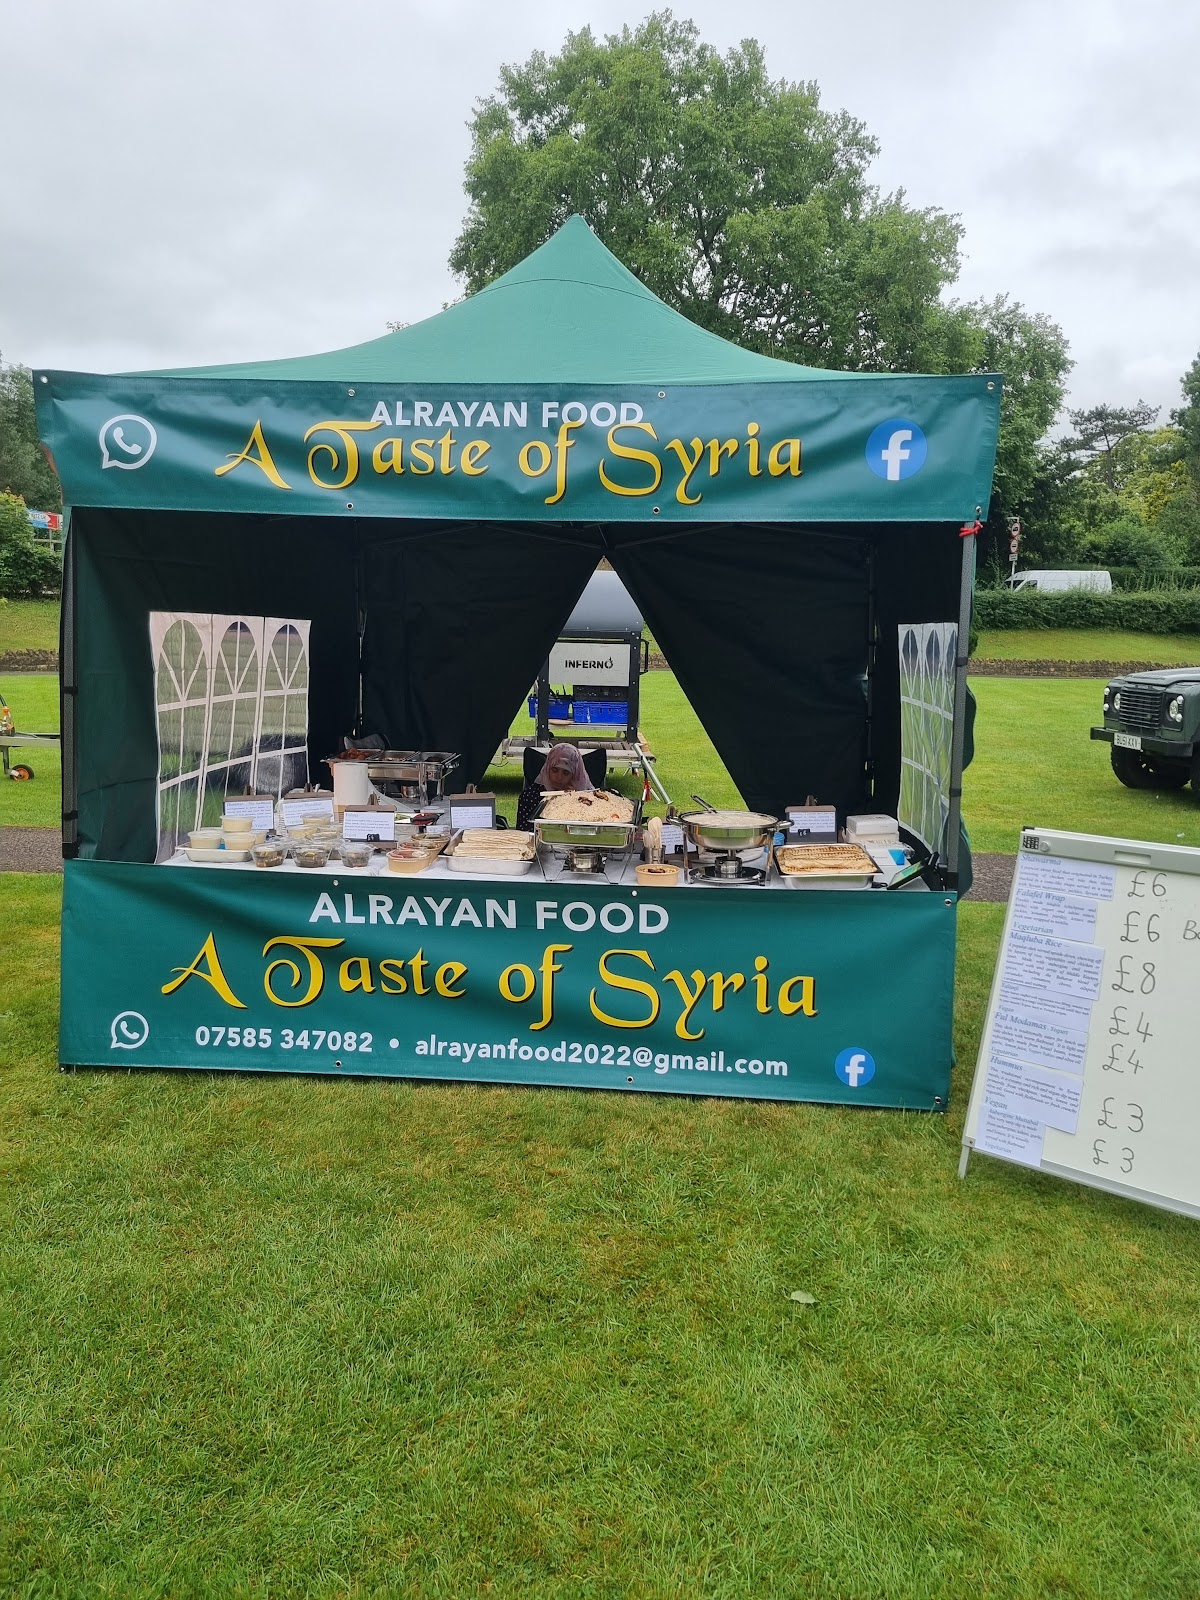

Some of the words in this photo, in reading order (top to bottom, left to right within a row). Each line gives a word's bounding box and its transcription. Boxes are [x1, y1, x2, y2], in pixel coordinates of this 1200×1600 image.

[370, 401, 528, 428] ALRAYAN
[543, 401, 644, 429] FOOD
[216, 419, 291, 490] A
[304, 421, 488, 489] Taste
[518, 420, 582, 504] of
[598, 422, 803, 504] Syria
[565, 656, 614, 669] INFERNO
[1021, 854, 1062, 866] Shawarma
[1017, 888, 1043, 900] Falafel
[1045, 893, 1066, 903] Wrap
[1128, 871, 1167, 897] £6
[309, 892, 518, 930] ALRAYAN
[536, 898, 670, 935] FOOD
[1009, 931, 1043, 945] Maqluba
[1045, 937, 1063, 948] Rice
[1013, 922, 1053, 934] Vegetarian
[1120, 911, 1160, 943] £6
[1183, 919, 1200, 941] B
[161, 931, 248, 1010] A
[262, 935, 468, 1008] Taste
[498, 943, 573, 1031] of
[589, 947, 819, 1041] Syria
[1112, 955, 1156, 994] £8
[995, 1012, 1008, 1022] Ful
[1109, 1006, 1153, 1042] £4
[195, 1025, 272, 1050] 07585
[280, 1028, 374, 1054] 347082
[415, 1034, 789, 1077] alrayanfood2022@gmail.com
[990, 1056, 1024, 1071] Hummus
[1102, 1043, 1144, 1074] £4
[986, 1096, 1008, 1109] Vegan
